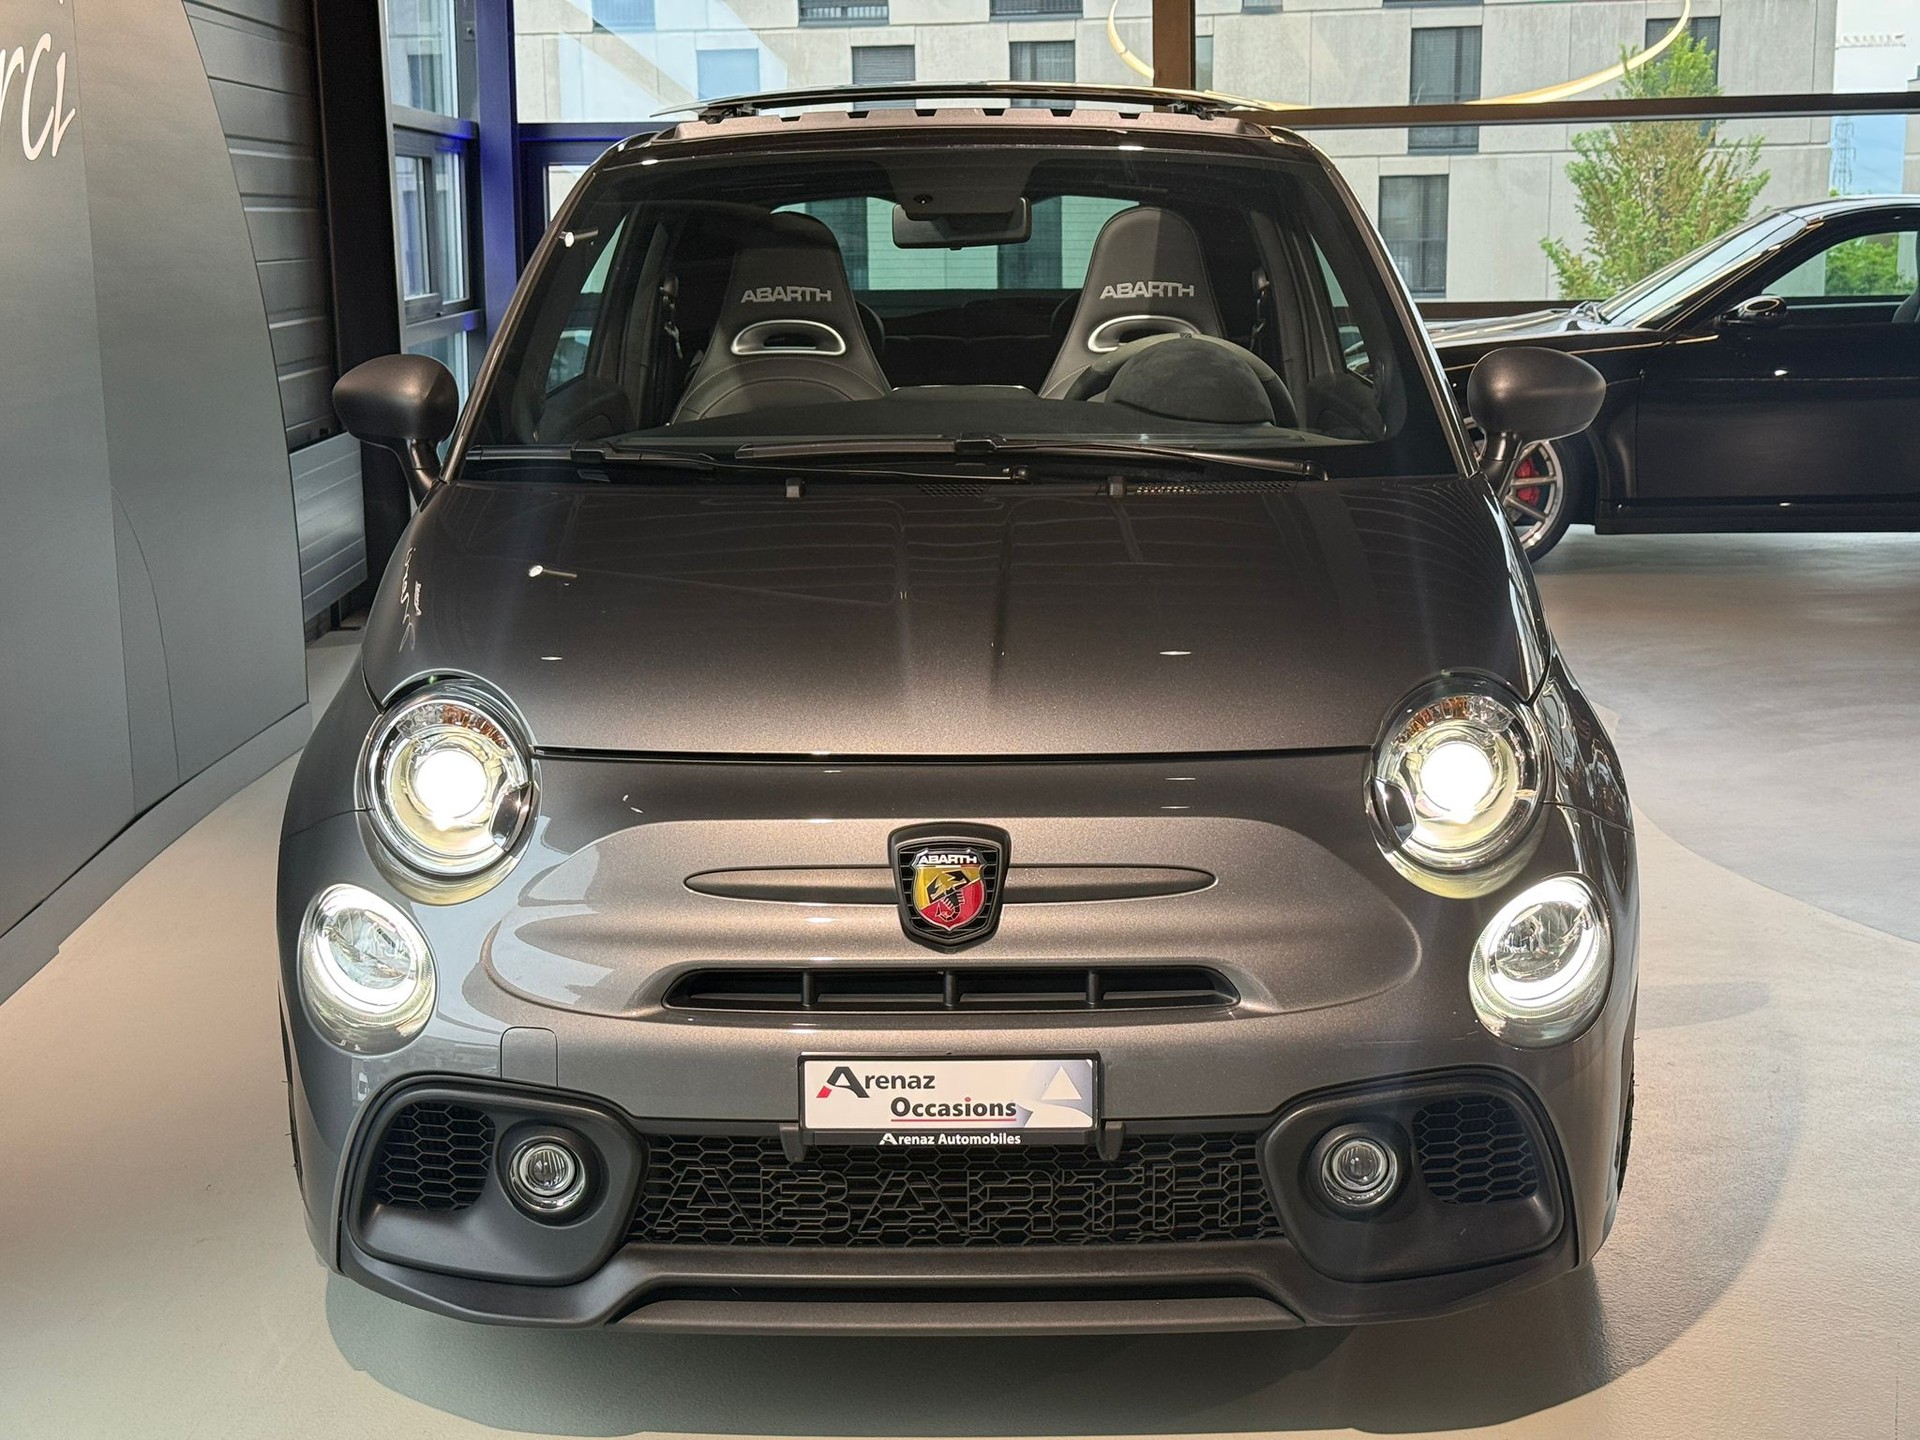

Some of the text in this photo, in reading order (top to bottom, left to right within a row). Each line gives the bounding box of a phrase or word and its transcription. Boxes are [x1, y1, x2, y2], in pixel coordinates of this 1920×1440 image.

[740, 286, 832, 303] ABARTH
[1100, 281, 1195, 300] ABARTH
[919, 854, 977, 865] ABARTH
[816, 1066, 936, 1098] Arenaz
[890, 1096, 1017, 1118] Occasions
[879, 1132, 1021, 1146] Arenaz Automobiles
[653, 1165, 1242, 1235] ABARTH
